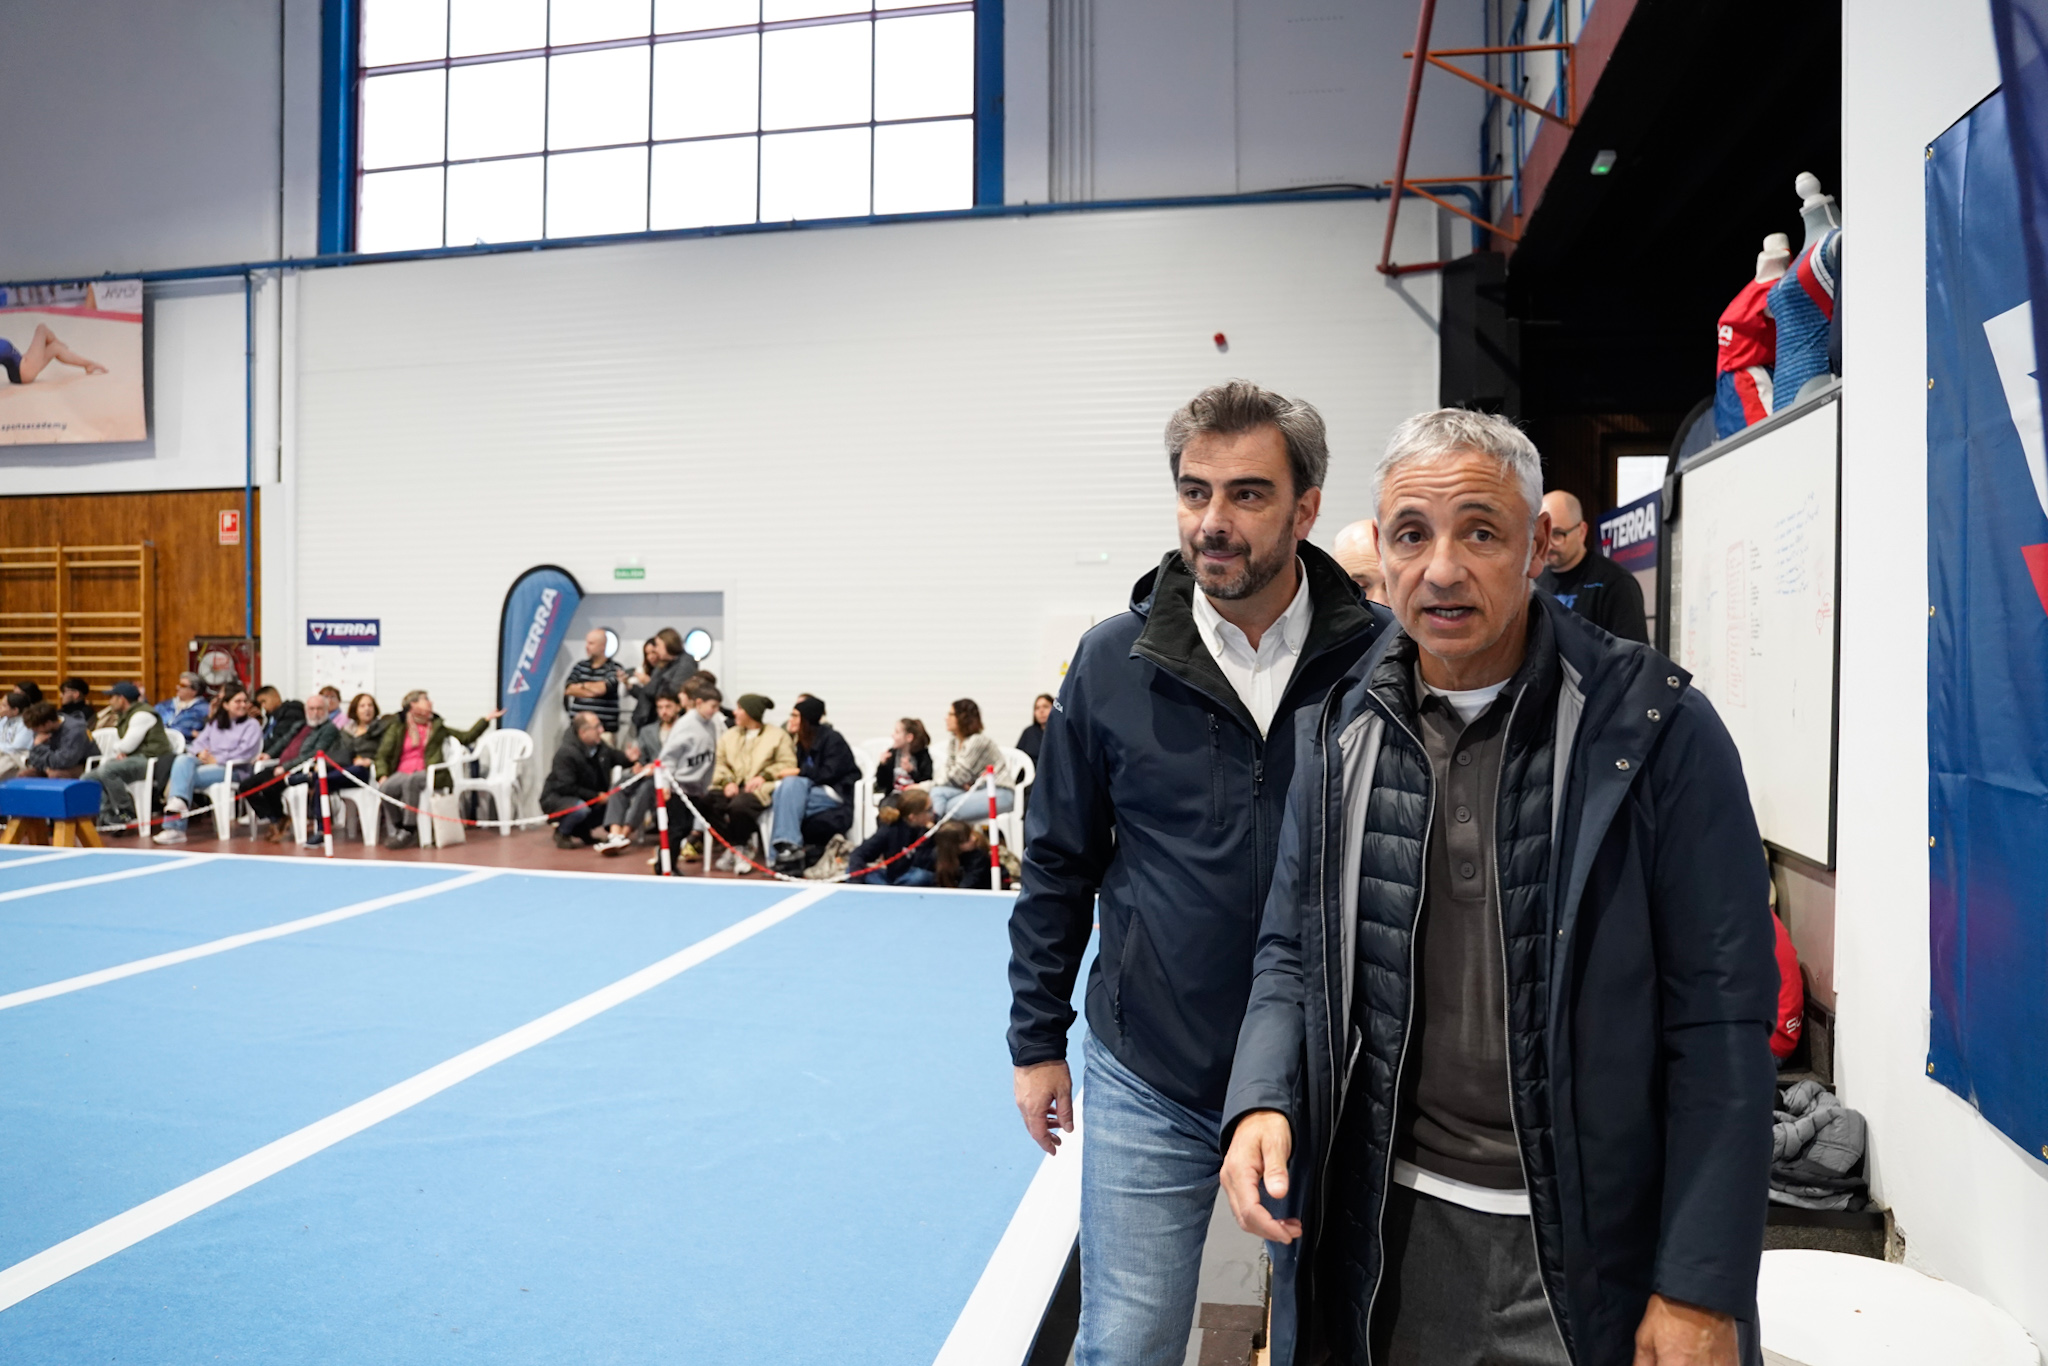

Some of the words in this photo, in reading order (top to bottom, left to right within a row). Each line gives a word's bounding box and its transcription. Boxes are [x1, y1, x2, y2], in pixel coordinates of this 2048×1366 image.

[1611, 502, 1656, 550] TERRA
[325, 622, 377, 636] TERRA
[517, 587, 559, 671] TERRA
